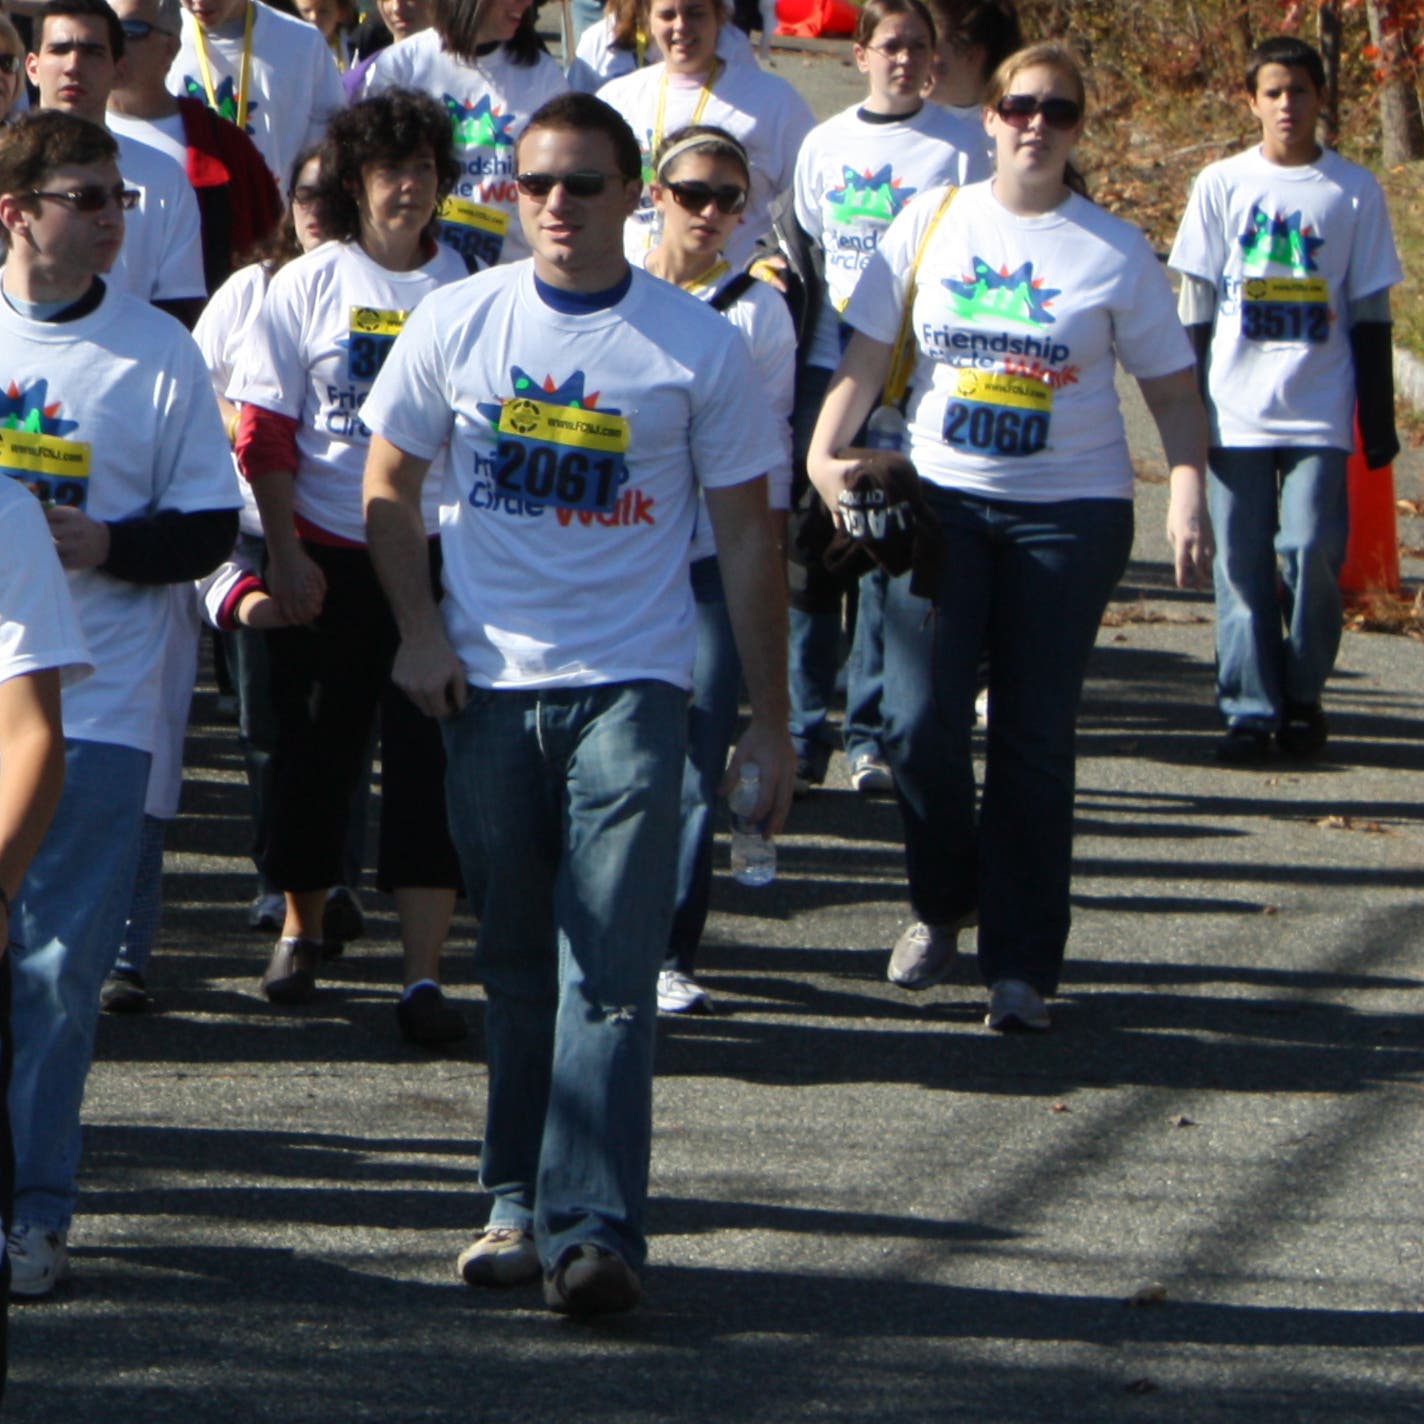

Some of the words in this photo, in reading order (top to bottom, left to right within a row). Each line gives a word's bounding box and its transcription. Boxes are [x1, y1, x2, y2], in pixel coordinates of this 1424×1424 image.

[922, 323, 1070, 364] Friendship
[1244, 304, 1328, 344] 3512
[547, 417, 622, 439] www.FCNJ.com
[944, 402, 1049, 454] 2060
[500, 441, 614, 508] 2061
